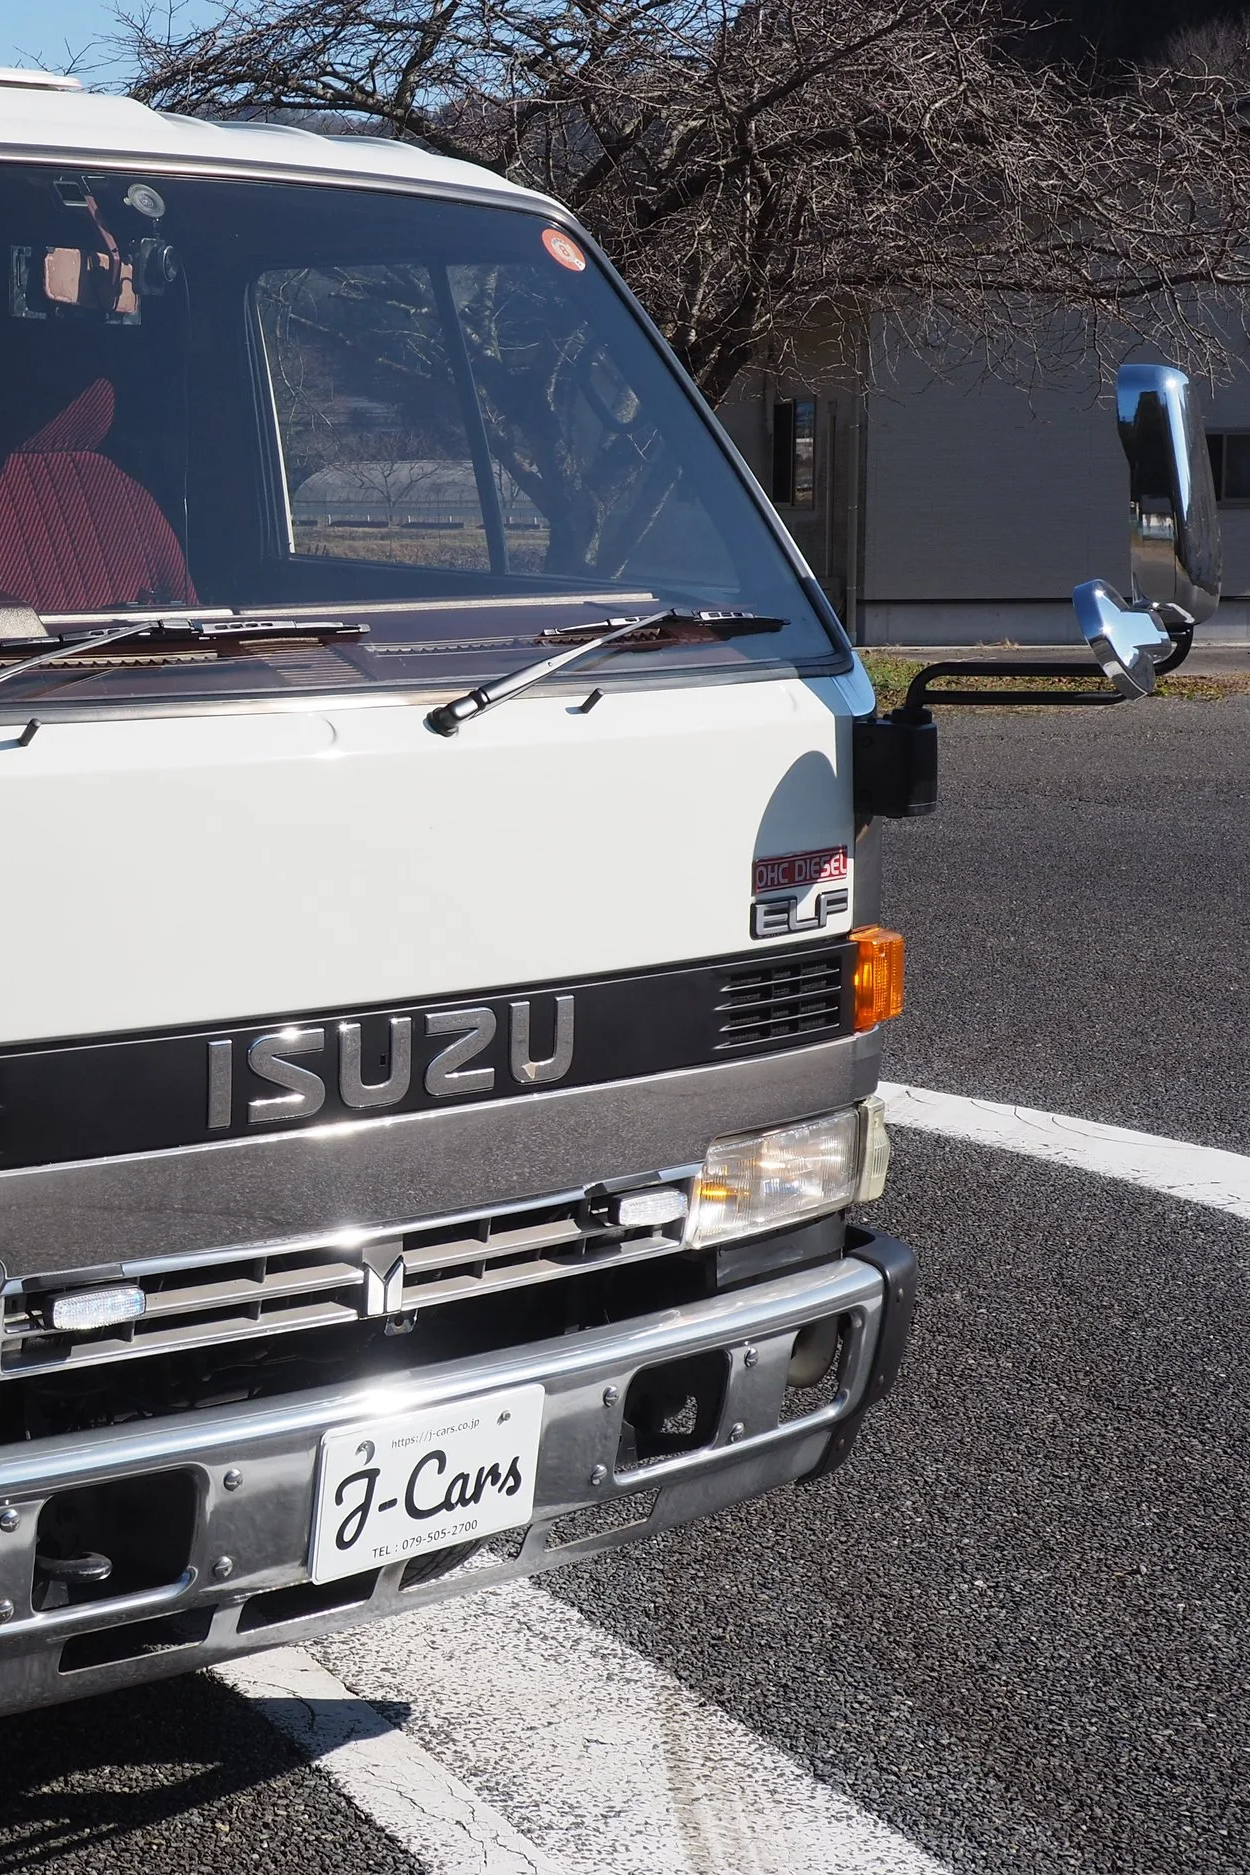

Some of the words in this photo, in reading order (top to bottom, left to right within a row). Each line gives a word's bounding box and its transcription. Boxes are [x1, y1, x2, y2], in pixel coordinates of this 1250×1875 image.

[756, 862, 789, 888] OHC
[795, 852, 847, 881] DIESEL
[753, 889, 848, 937] ELF
[207, 995, 575, 1129] ISUZU
[391, 1418, 480, 1449] https://j-cars.co.jp
[402, 1519, 478, 1550] 079-505-2700
